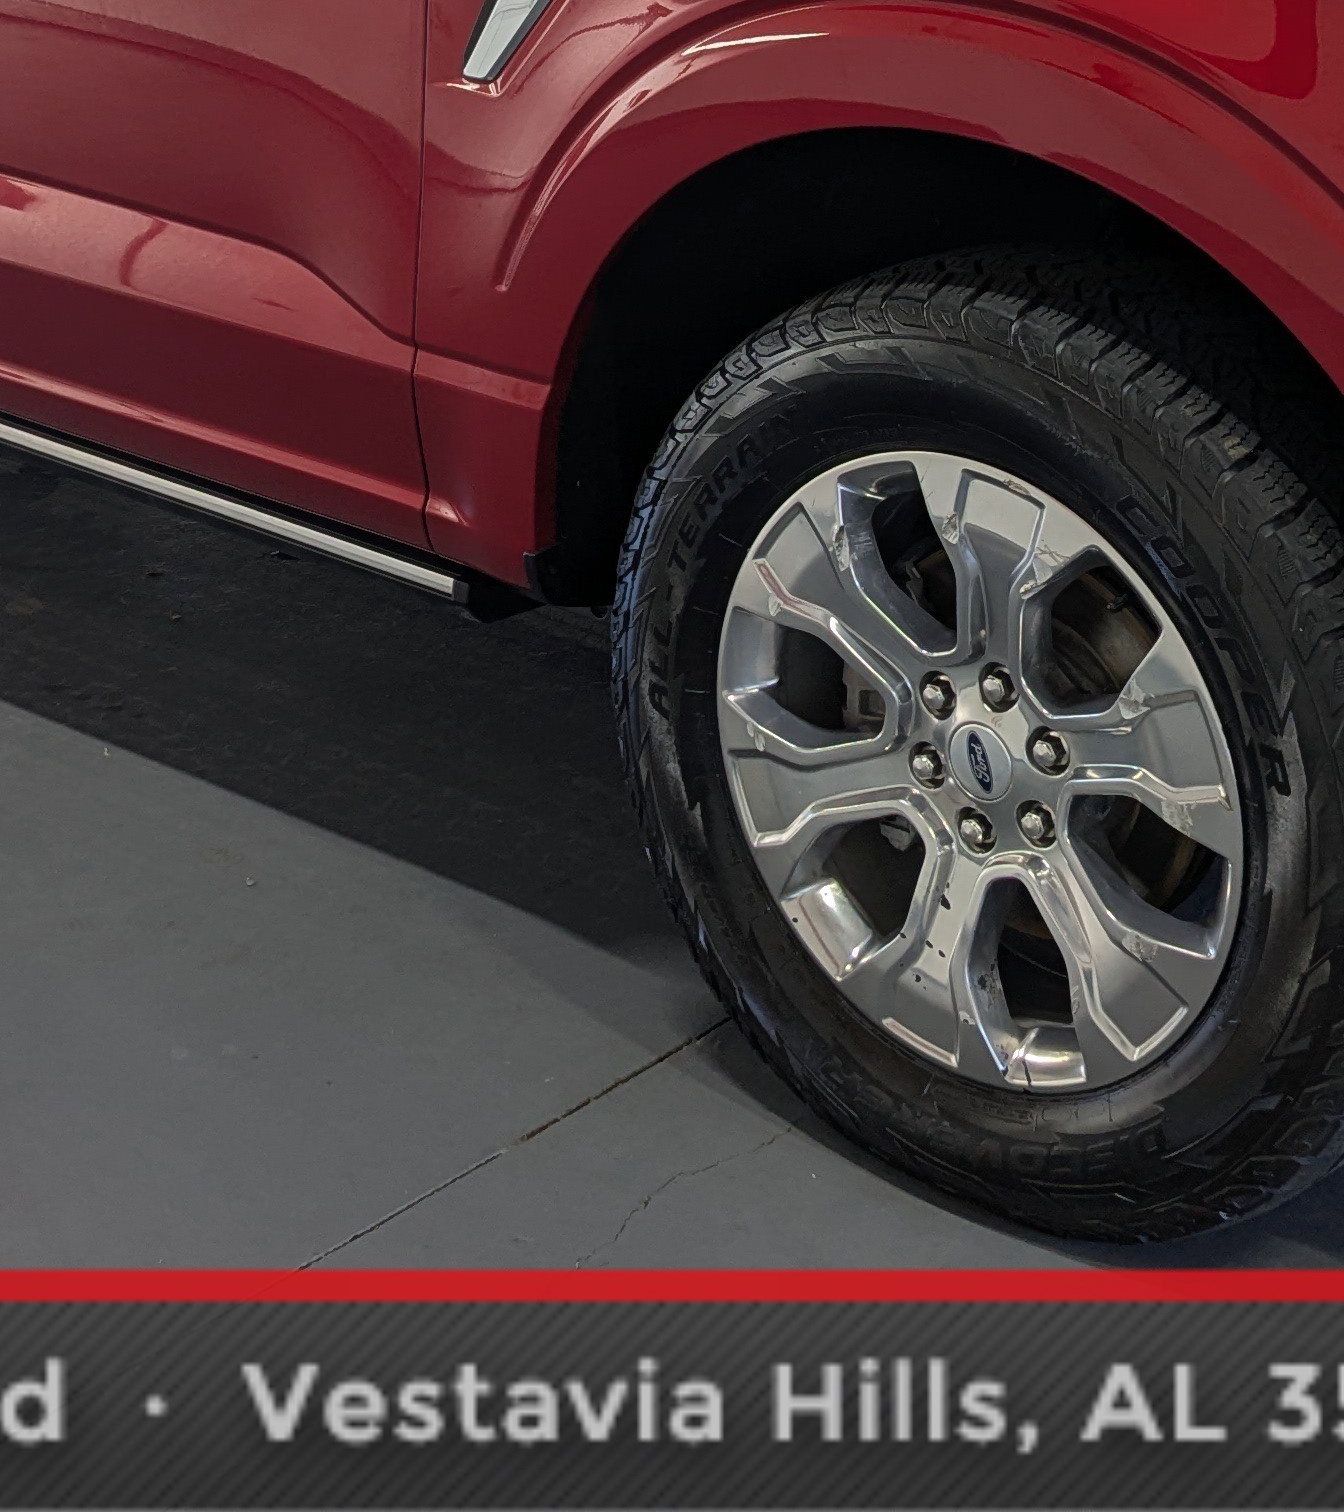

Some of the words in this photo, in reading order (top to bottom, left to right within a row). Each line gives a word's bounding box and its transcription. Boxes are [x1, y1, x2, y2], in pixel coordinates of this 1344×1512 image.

[646, 404, 799, 721] ALL-TERRAIN
[1115, 495, 1292, 797] COOPER
[970, 741, 991, 784] Ford
